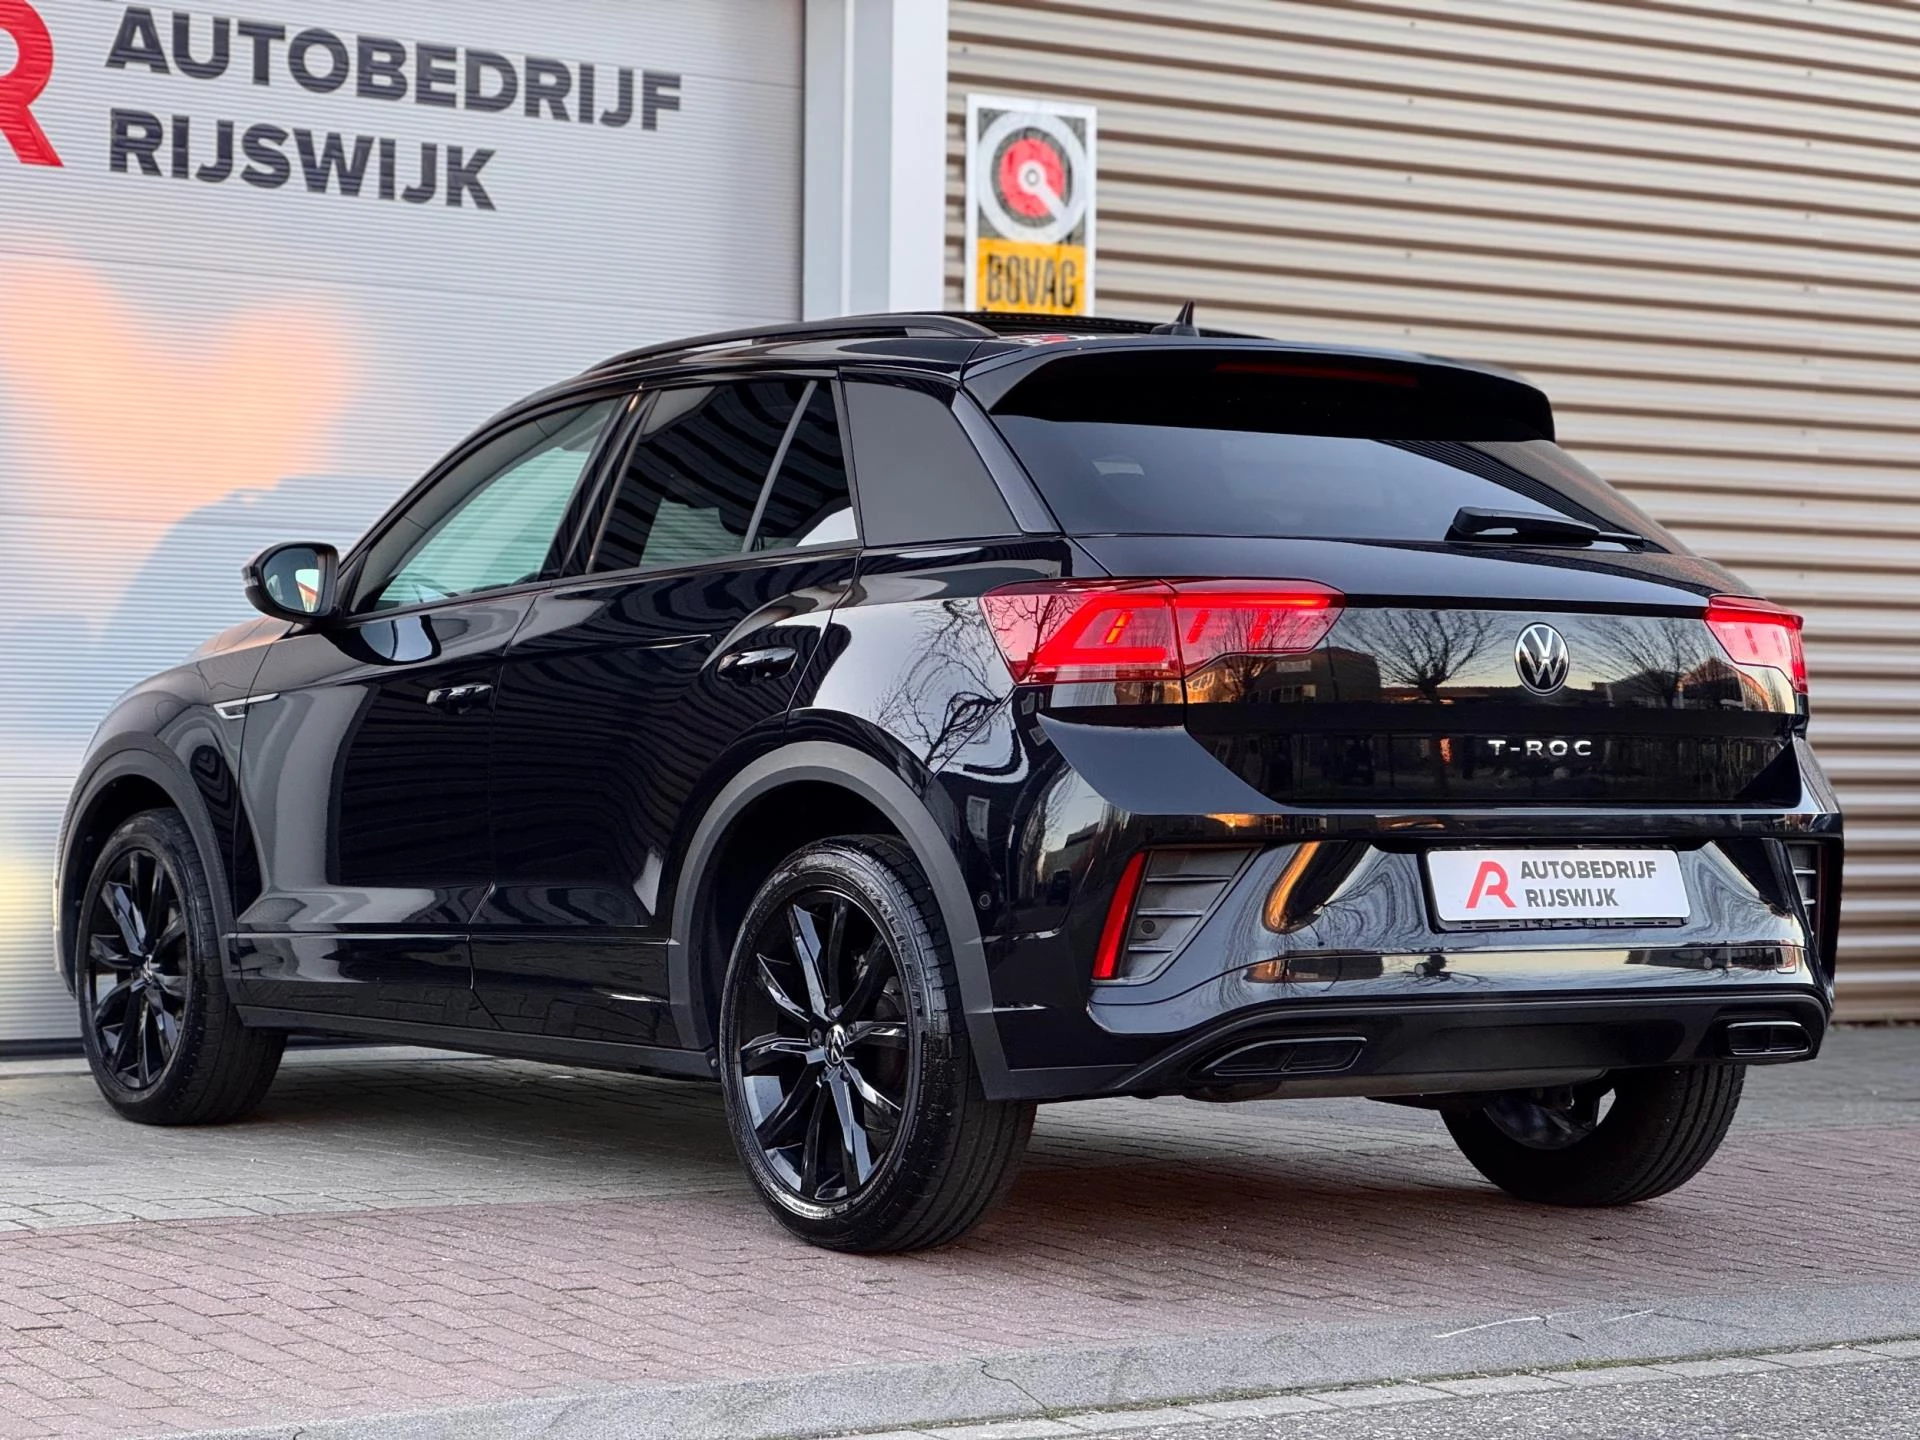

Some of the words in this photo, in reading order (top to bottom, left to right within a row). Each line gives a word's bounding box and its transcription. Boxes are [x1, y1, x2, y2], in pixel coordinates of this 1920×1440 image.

[105, 6, 682, 131] AUTOBEDRIJF
[109, 107, 497, 211] RIJSWIJK
[986, 253, 1077, 309] BOVAG
[1487, 739, 1592, 756] T-ROC
[1520, 860, 1657, 880] AUTOBEDRIJF
[1525, 888, 1619, 908] RIJSWIJK
